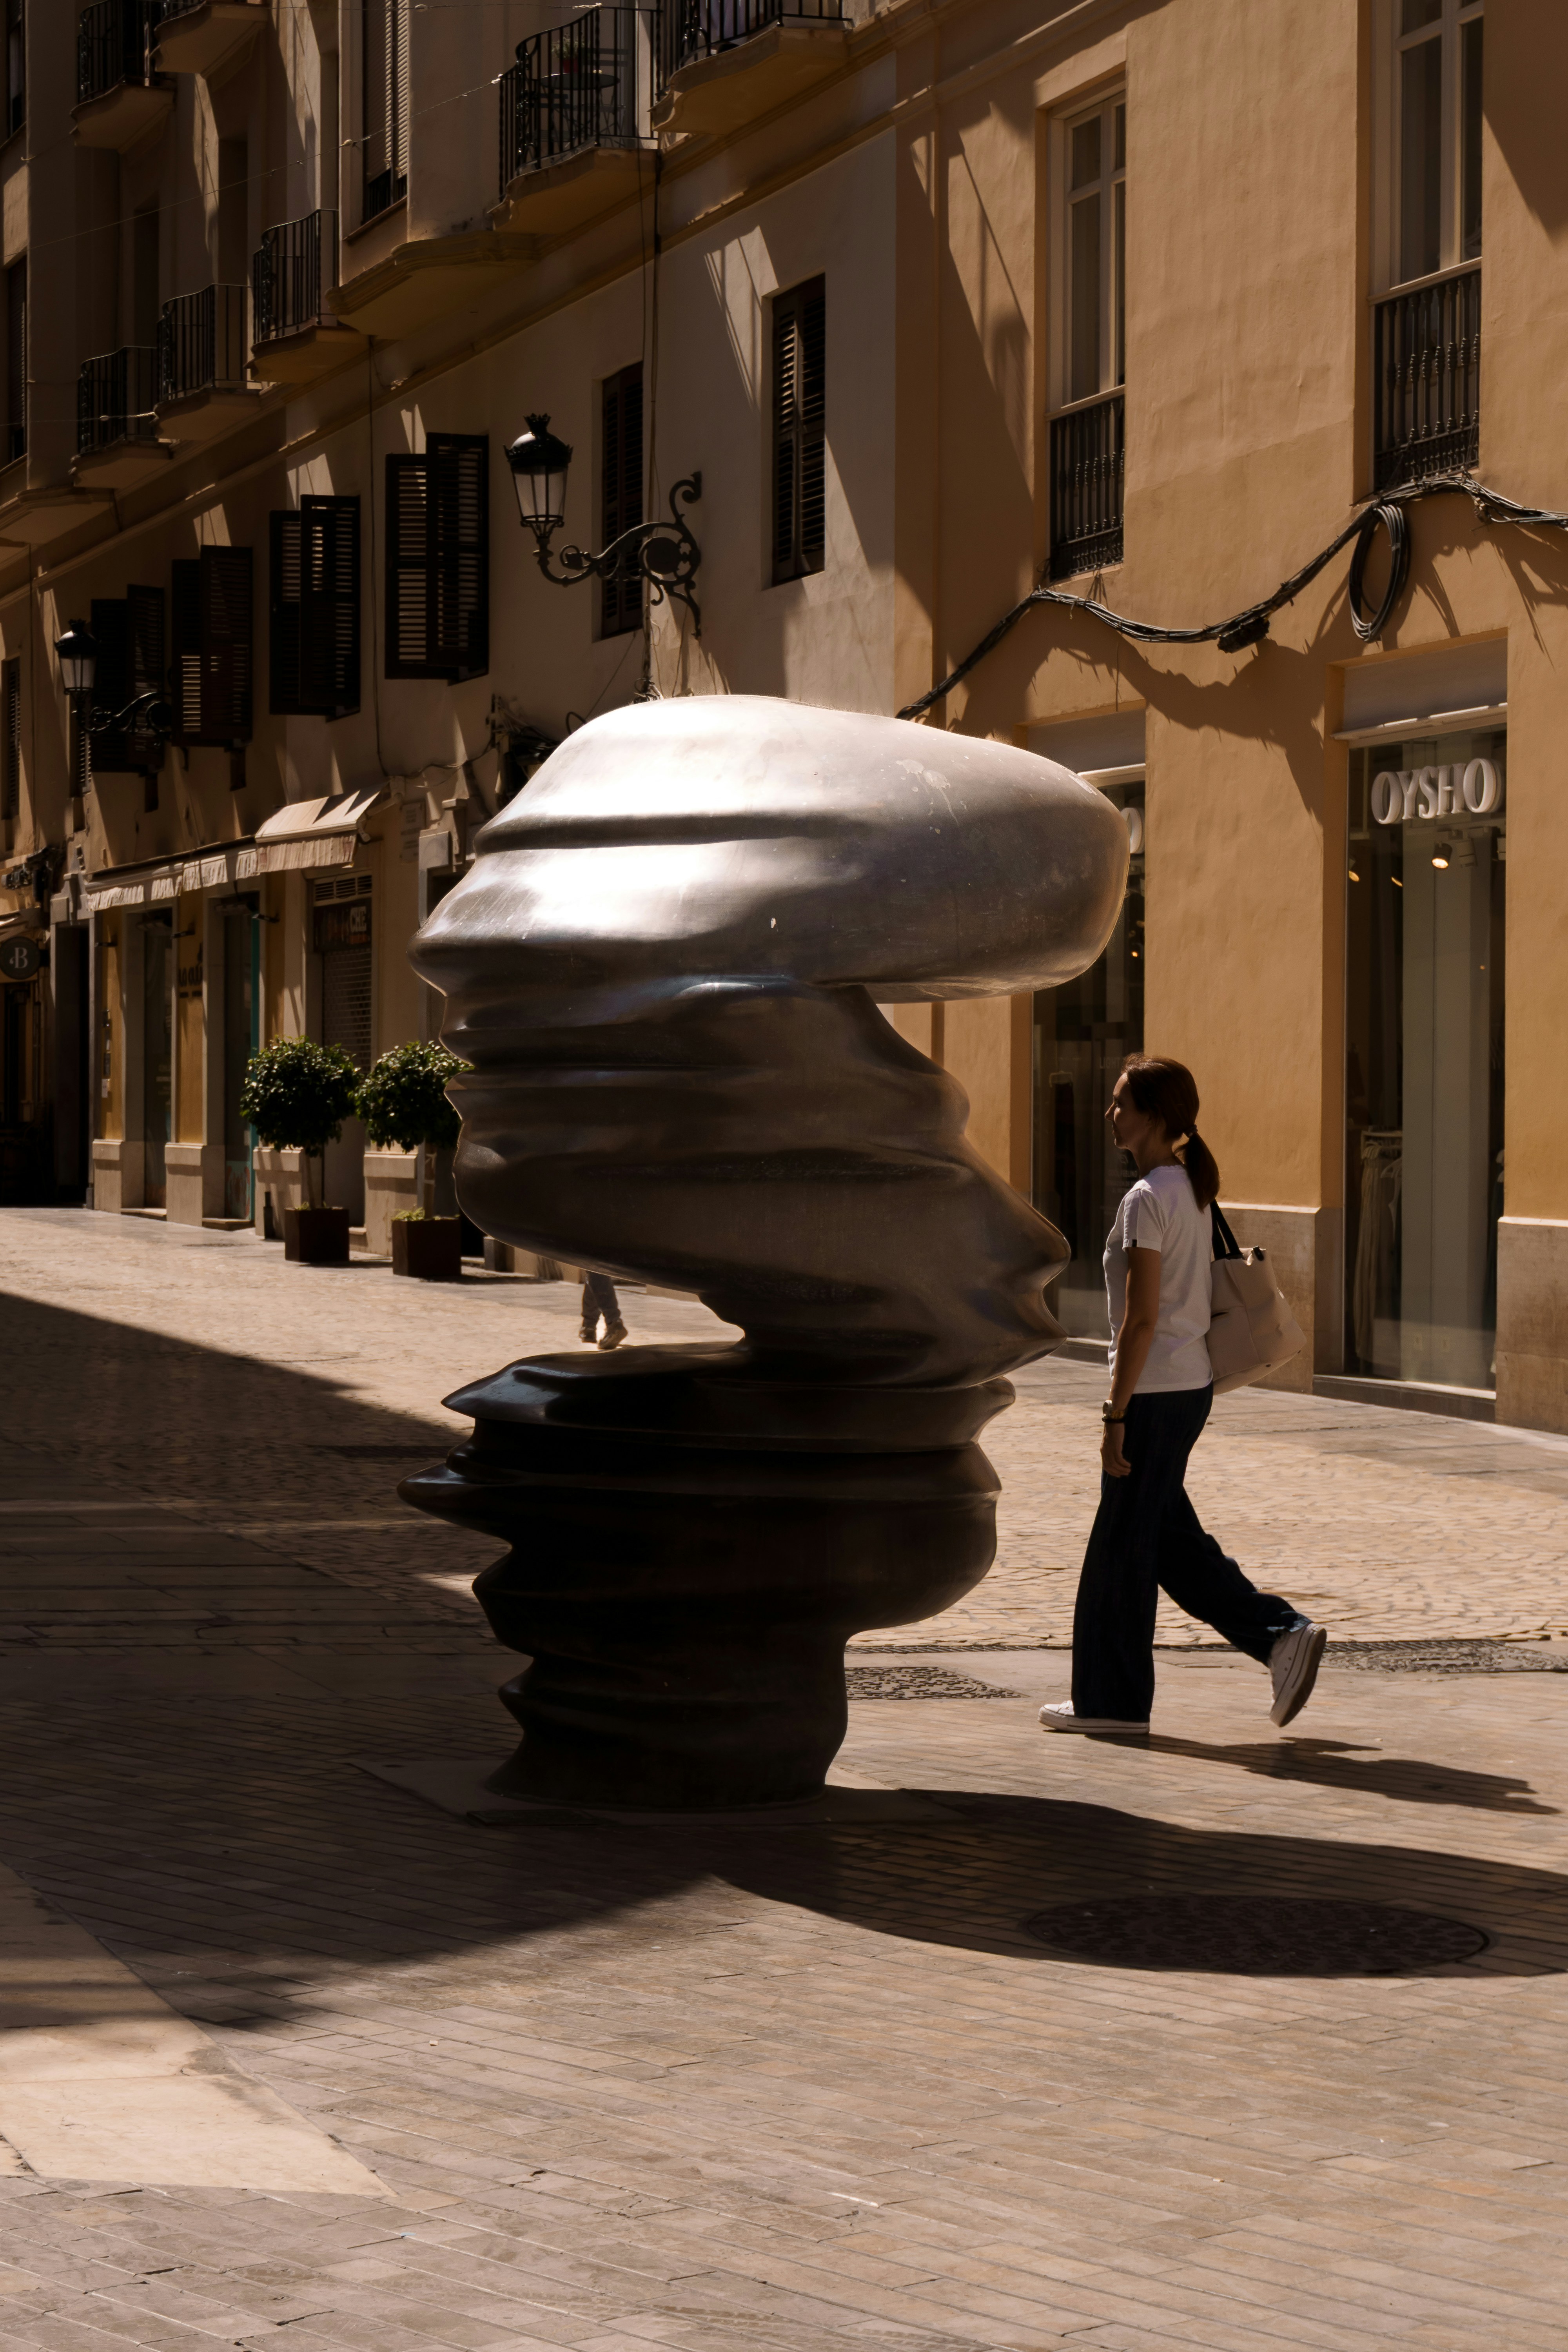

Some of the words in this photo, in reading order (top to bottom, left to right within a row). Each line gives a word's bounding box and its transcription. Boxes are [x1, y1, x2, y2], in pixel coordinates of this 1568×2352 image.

[1371, 758, 1497, 824] OYSHO
[9, 947, 28, 968] B
[1100, 1057, 1120, 1069] LIGHT
